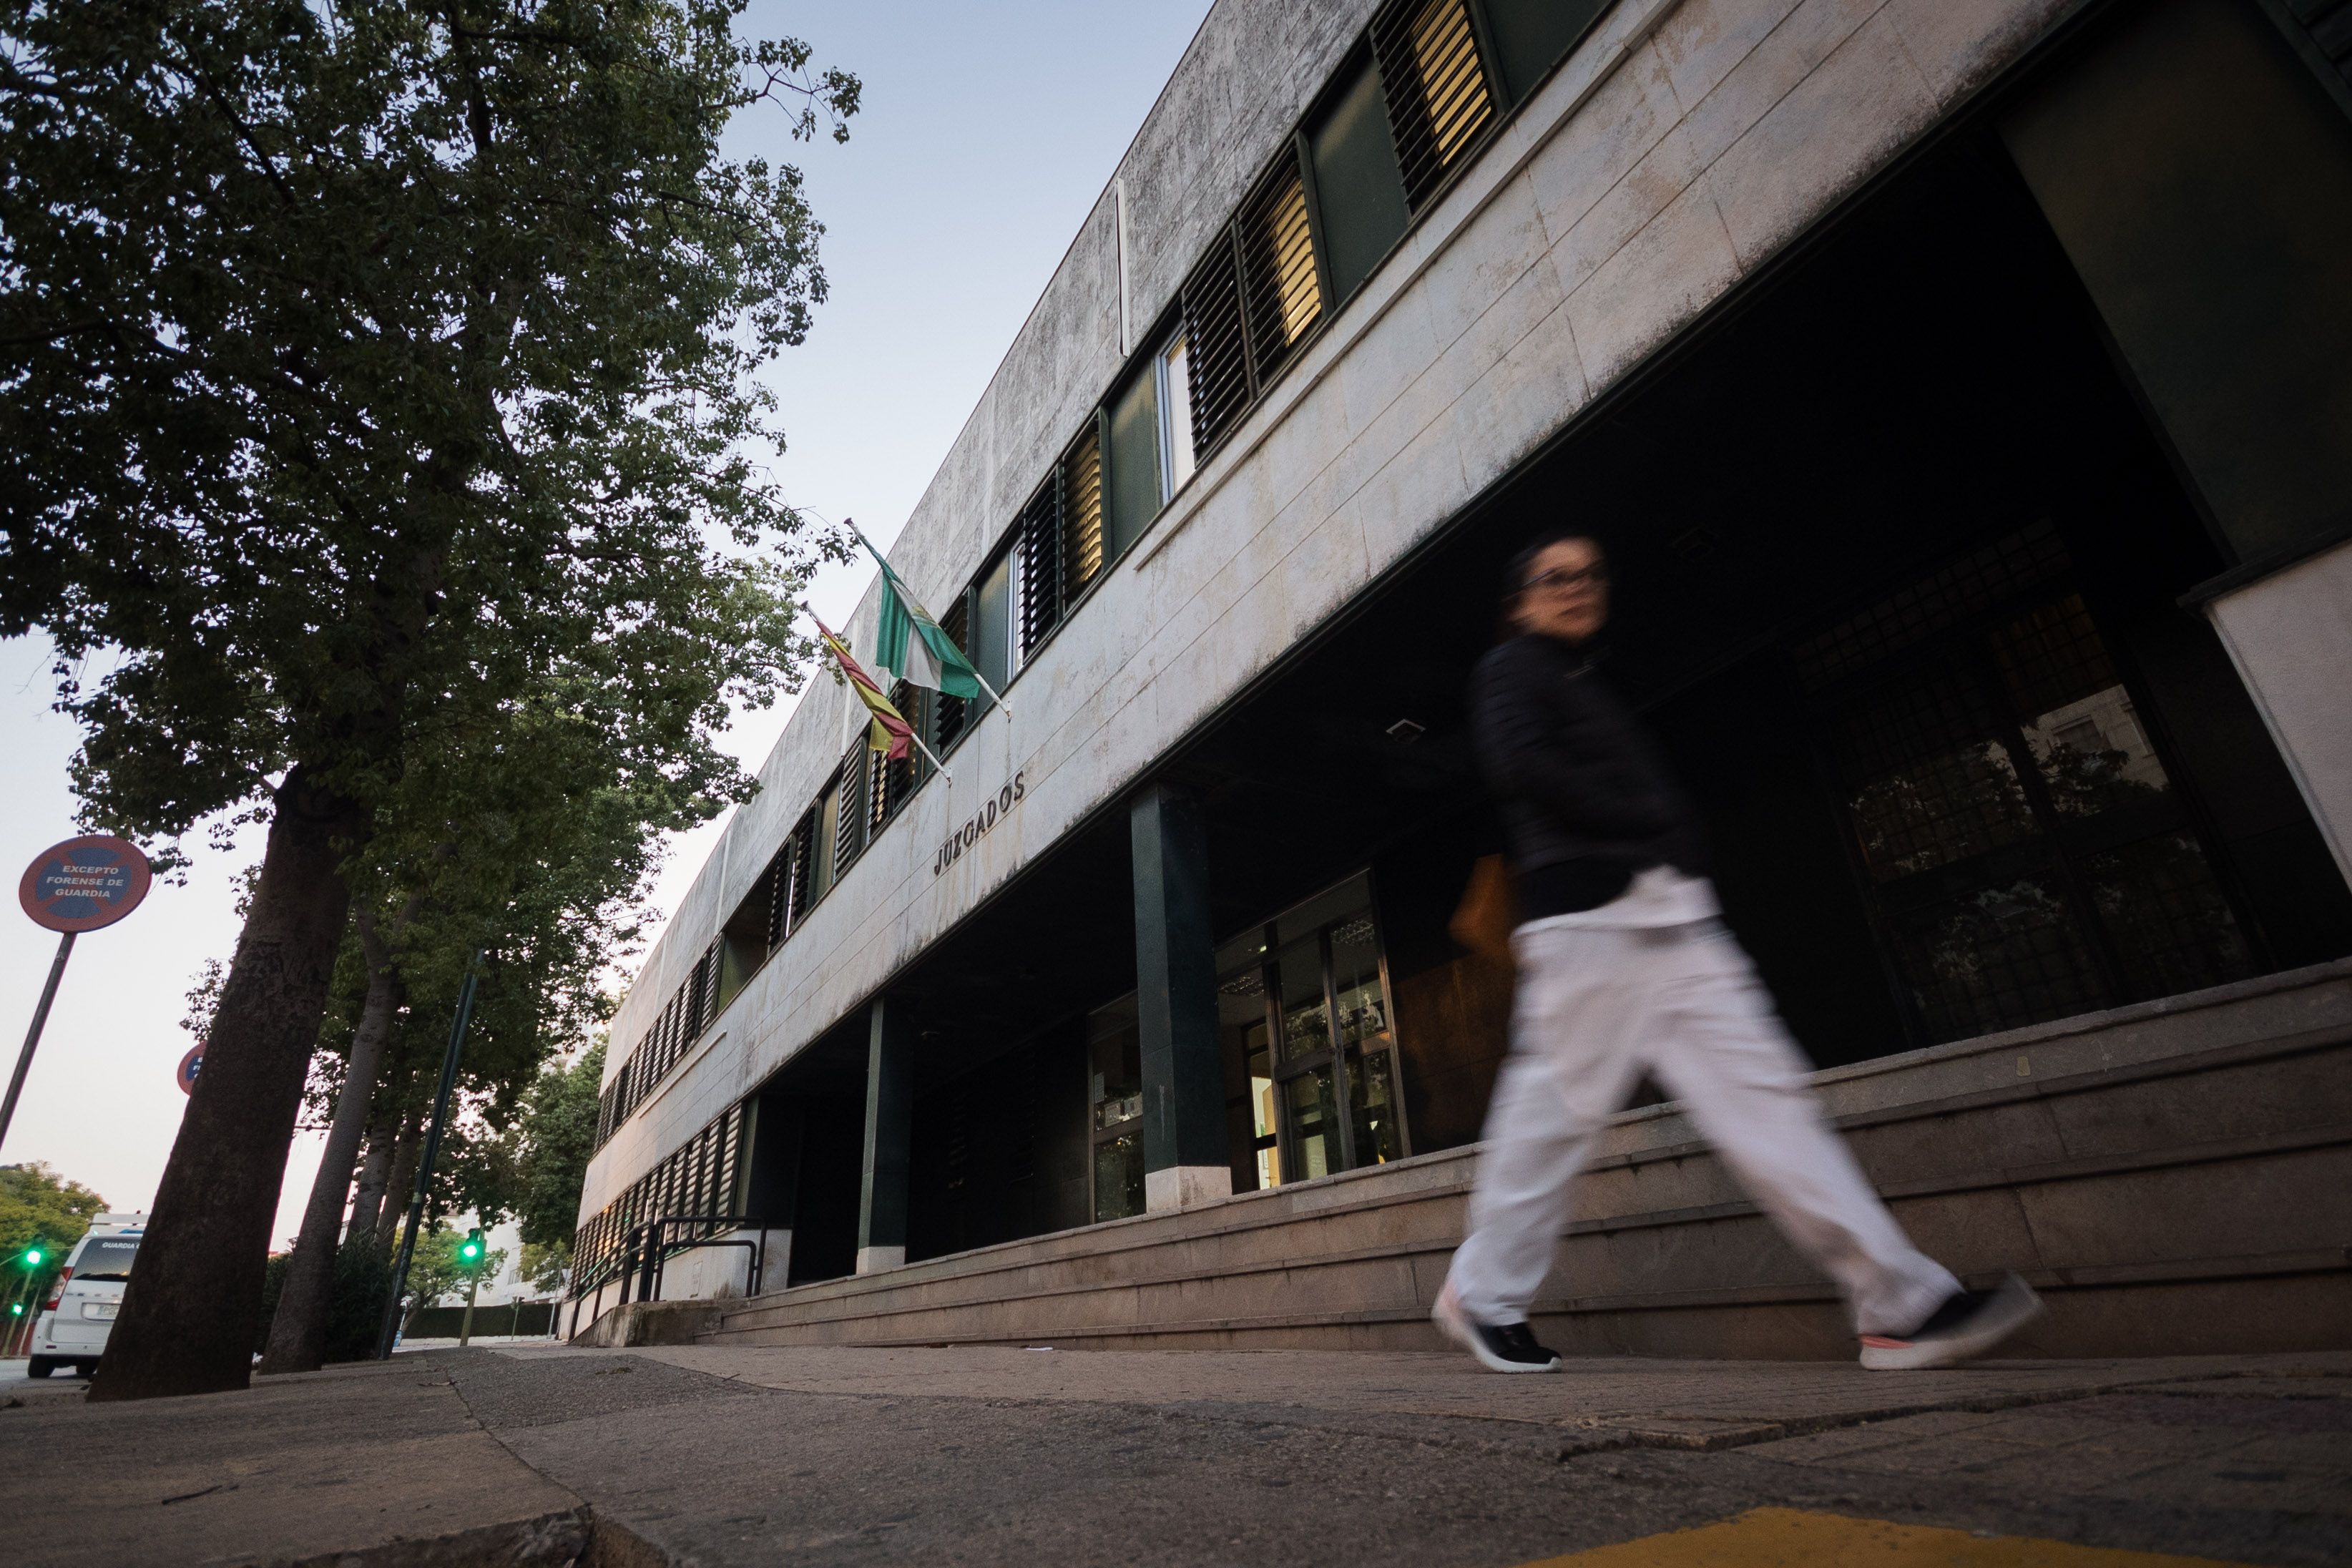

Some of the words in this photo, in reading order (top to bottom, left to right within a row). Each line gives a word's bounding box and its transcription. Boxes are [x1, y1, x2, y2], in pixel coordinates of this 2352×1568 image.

[934, 770, 1024, 876] JUZGADOS
[63, 865, 119, 874] EXCEPTO
[46, 876, 104, 886] FORENSE
[55, 888, 110, 898] GUARDIA
